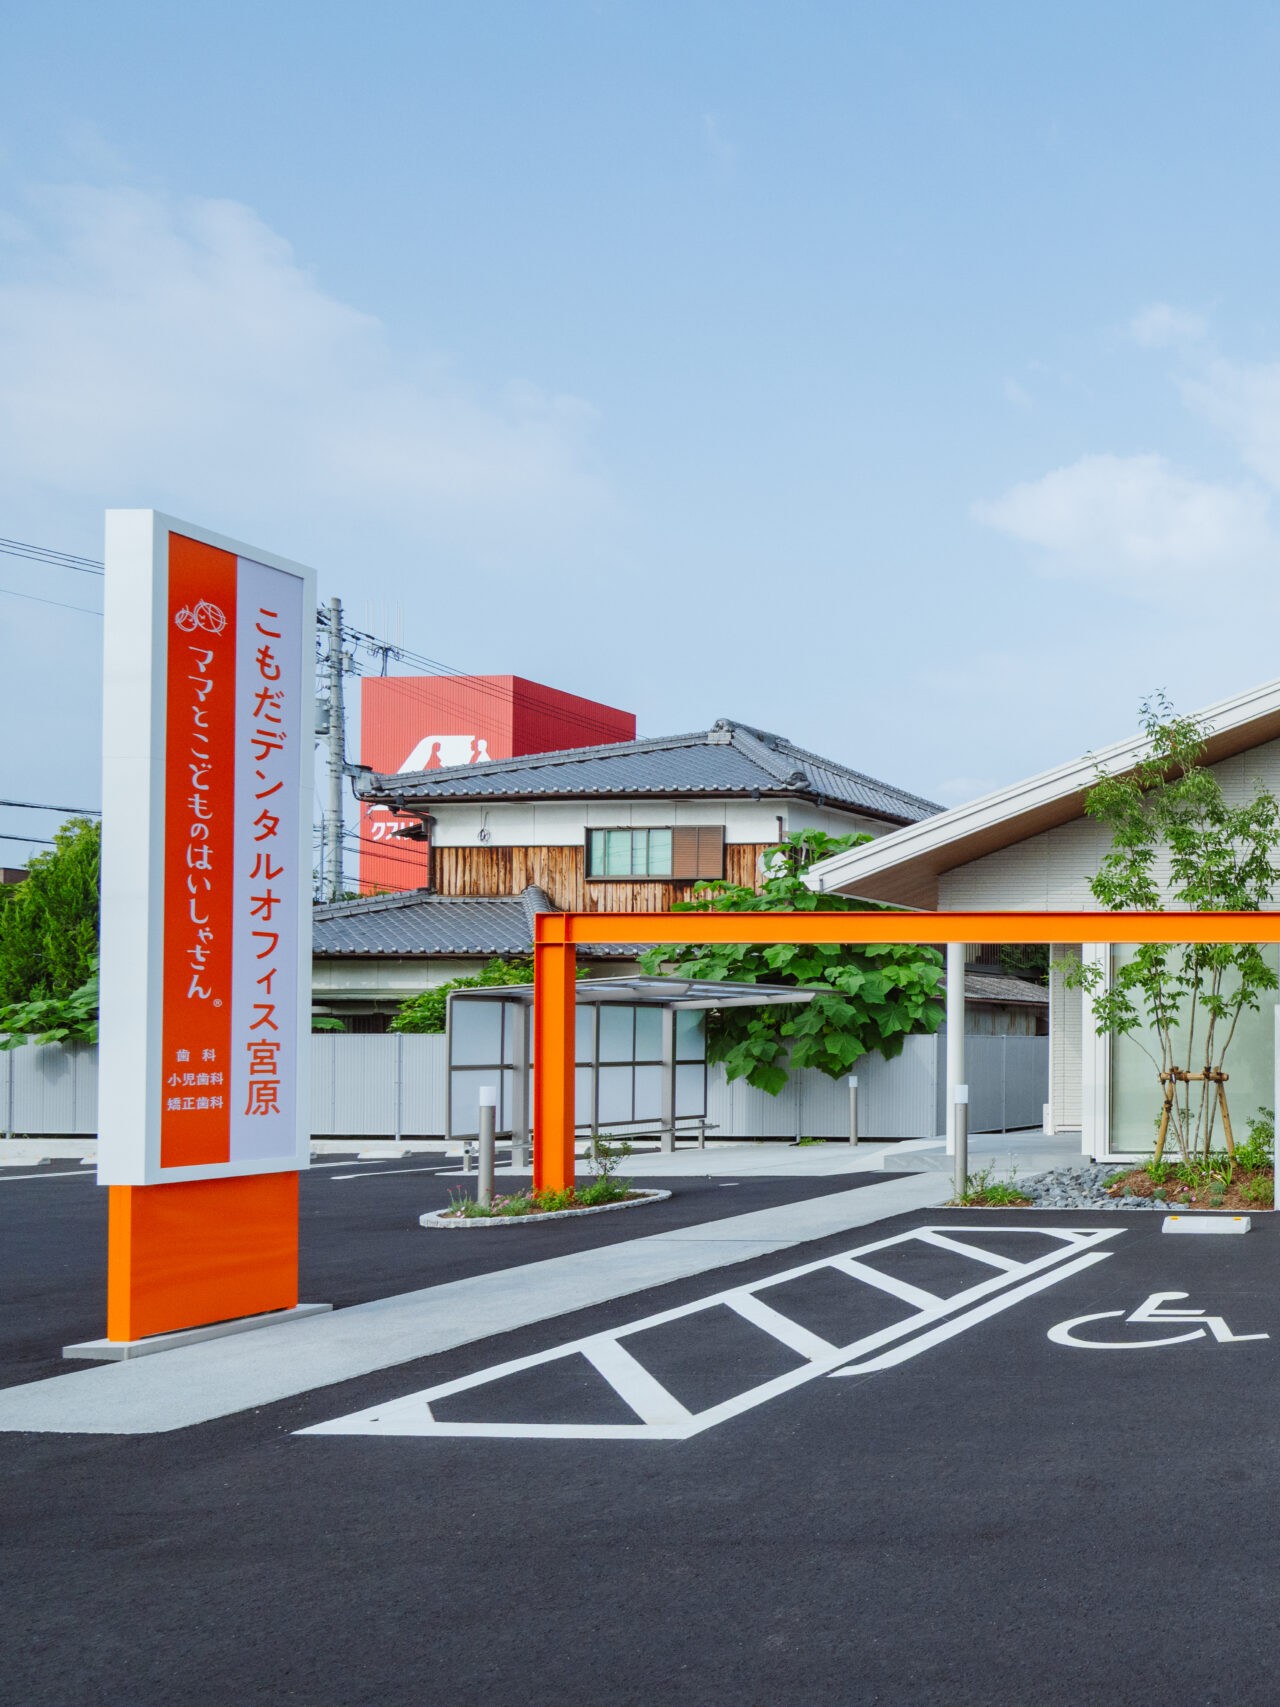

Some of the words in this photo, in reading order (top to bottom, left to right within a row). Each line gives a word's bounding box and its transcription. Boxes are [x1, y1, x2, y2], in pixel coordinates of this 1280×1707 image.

[243, 607, 288, 1116] こもだデンタルオフィス宮原
[167, 1072, 224, 1087] 小児歯科
[167, 1095, 224, 1111] 矯正歯科
